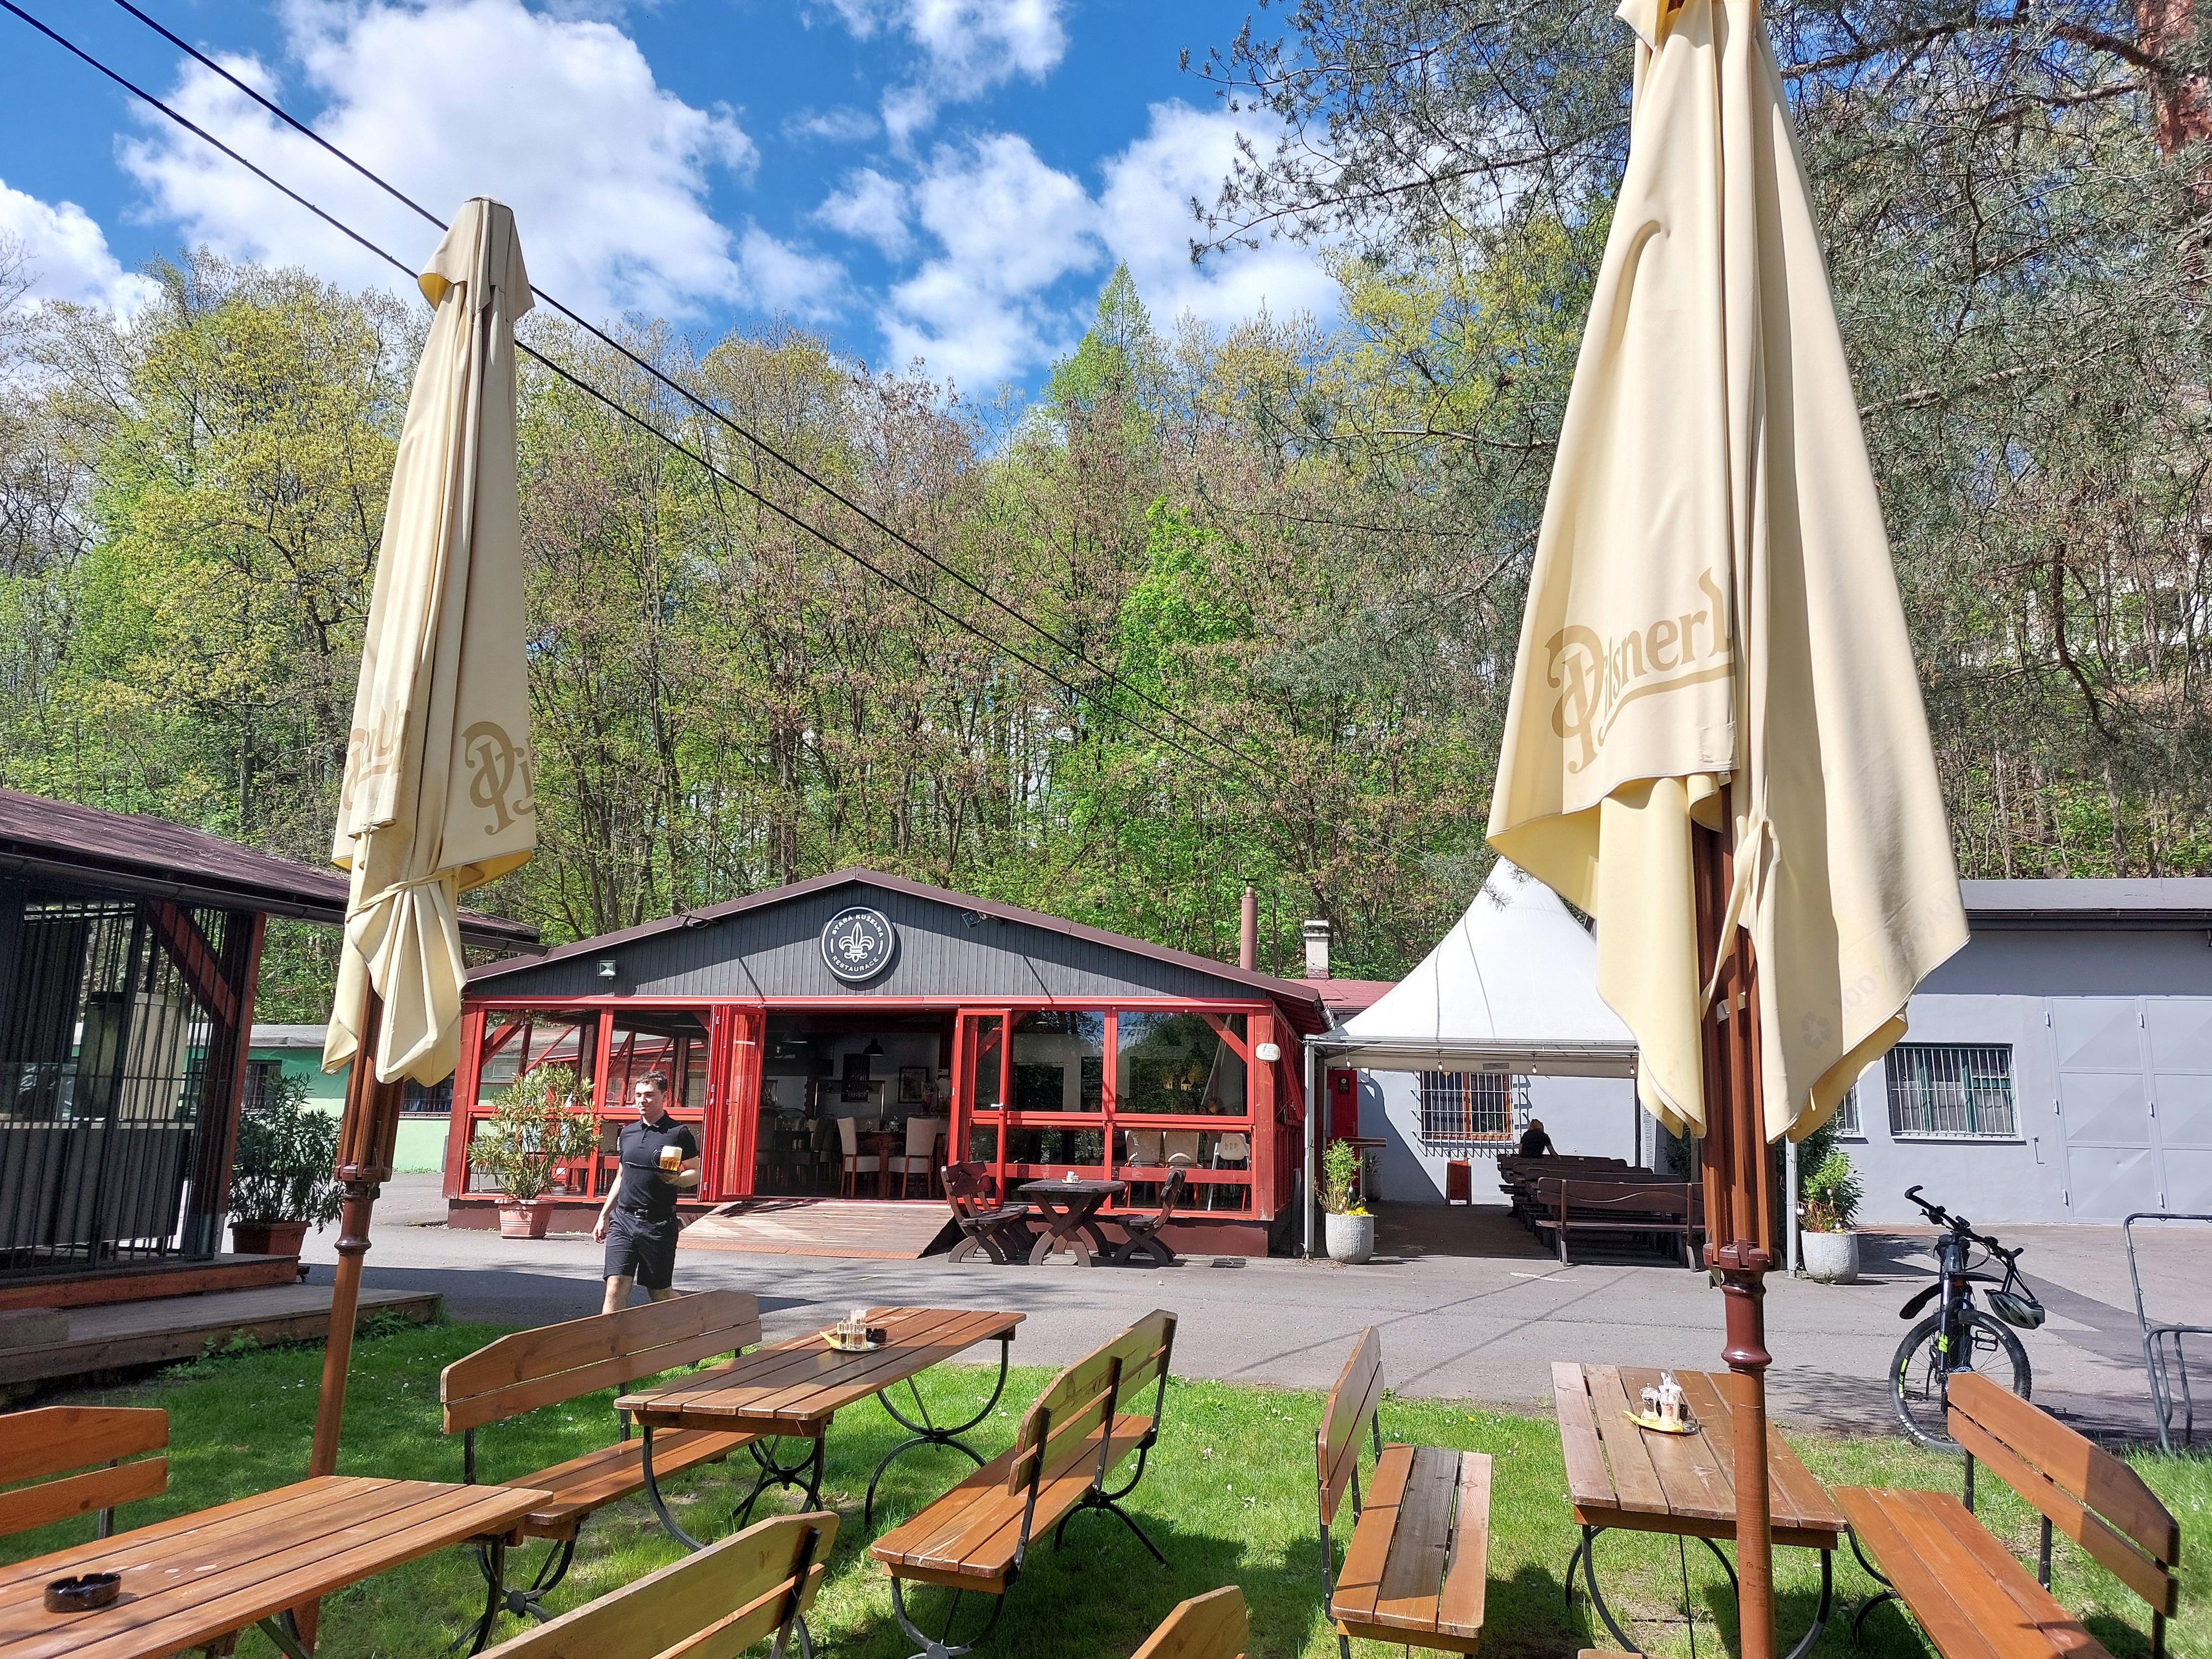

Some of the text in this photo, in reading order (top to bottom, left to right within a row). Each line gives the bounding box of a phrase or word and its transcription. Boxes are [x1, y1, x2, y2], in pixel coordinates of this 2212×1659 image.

[832, 914, 884, 937] STARÁ KUŽELNA
[832, 956, 878, 972] RESTAURACE
